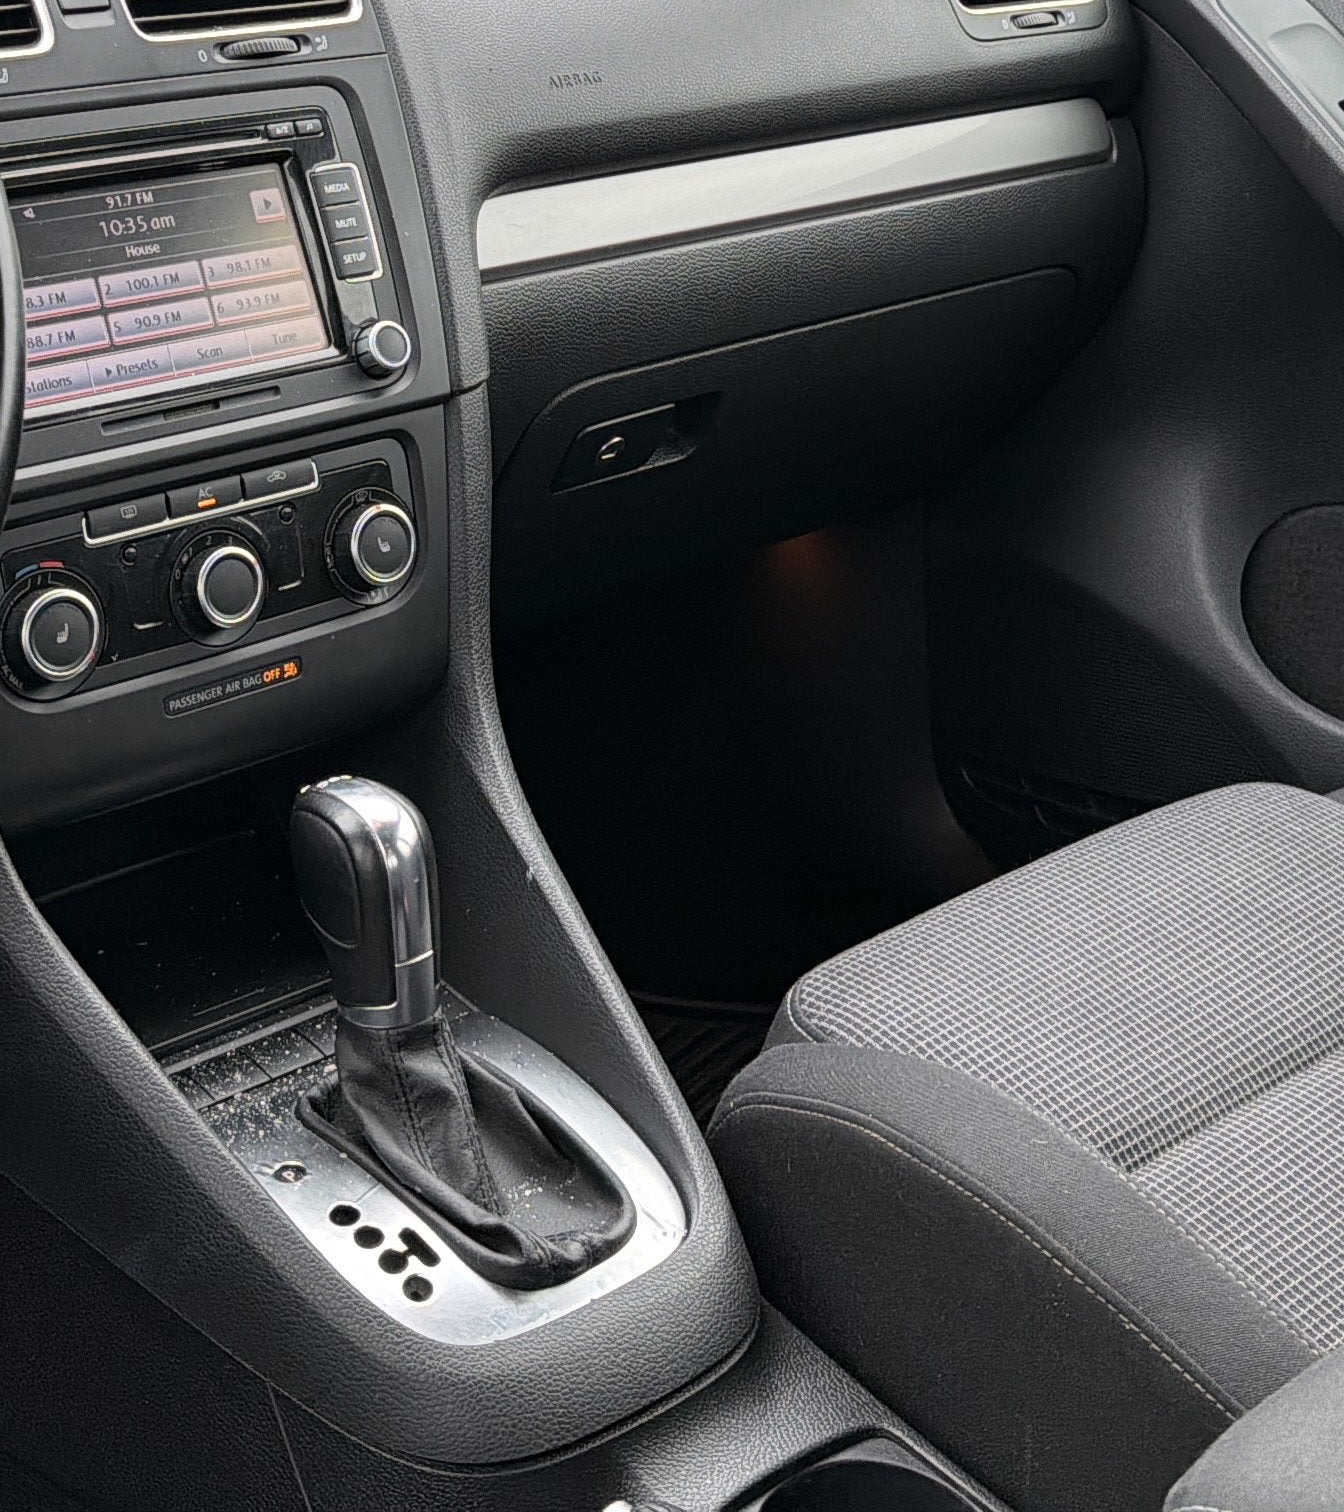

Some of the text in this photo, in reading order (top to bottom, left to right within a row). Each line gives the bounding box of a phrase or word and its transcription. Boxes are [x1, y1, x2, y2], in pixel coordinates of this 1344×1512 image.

[549, 71, 603, 89] AIRBAG
[323, 183, 351, 194] MEDIA
[106, 191, 154, 209] 91.7 FM
[99, 214, 176, 238] 10:35 am
[335, 218, 358, 228] MUTE
[124, 243, 161, 258] House
[342, 252, 367, 264] SETUP
[208, 257, 272, 278] 3 98.1 FM
[104, 272, 180, 295] 2 100.1 FM
[48, 291, 66, 305] FM
[217, 292, 281, 314] 6 93.9 FM
[135, 314, 162, 330] 90.9
[164, 310, 182, 324] FM
[26, 329, 76, 349] 88.7 FM
[116, 358, 159, 377] Presets
[197, 347, 224, 361] Scan
[272, 332, 297, 345] Tune
[198, 487, 214, 498] AC
[169, 668, 281, 711] PASSENGER AIR BAG OFF
